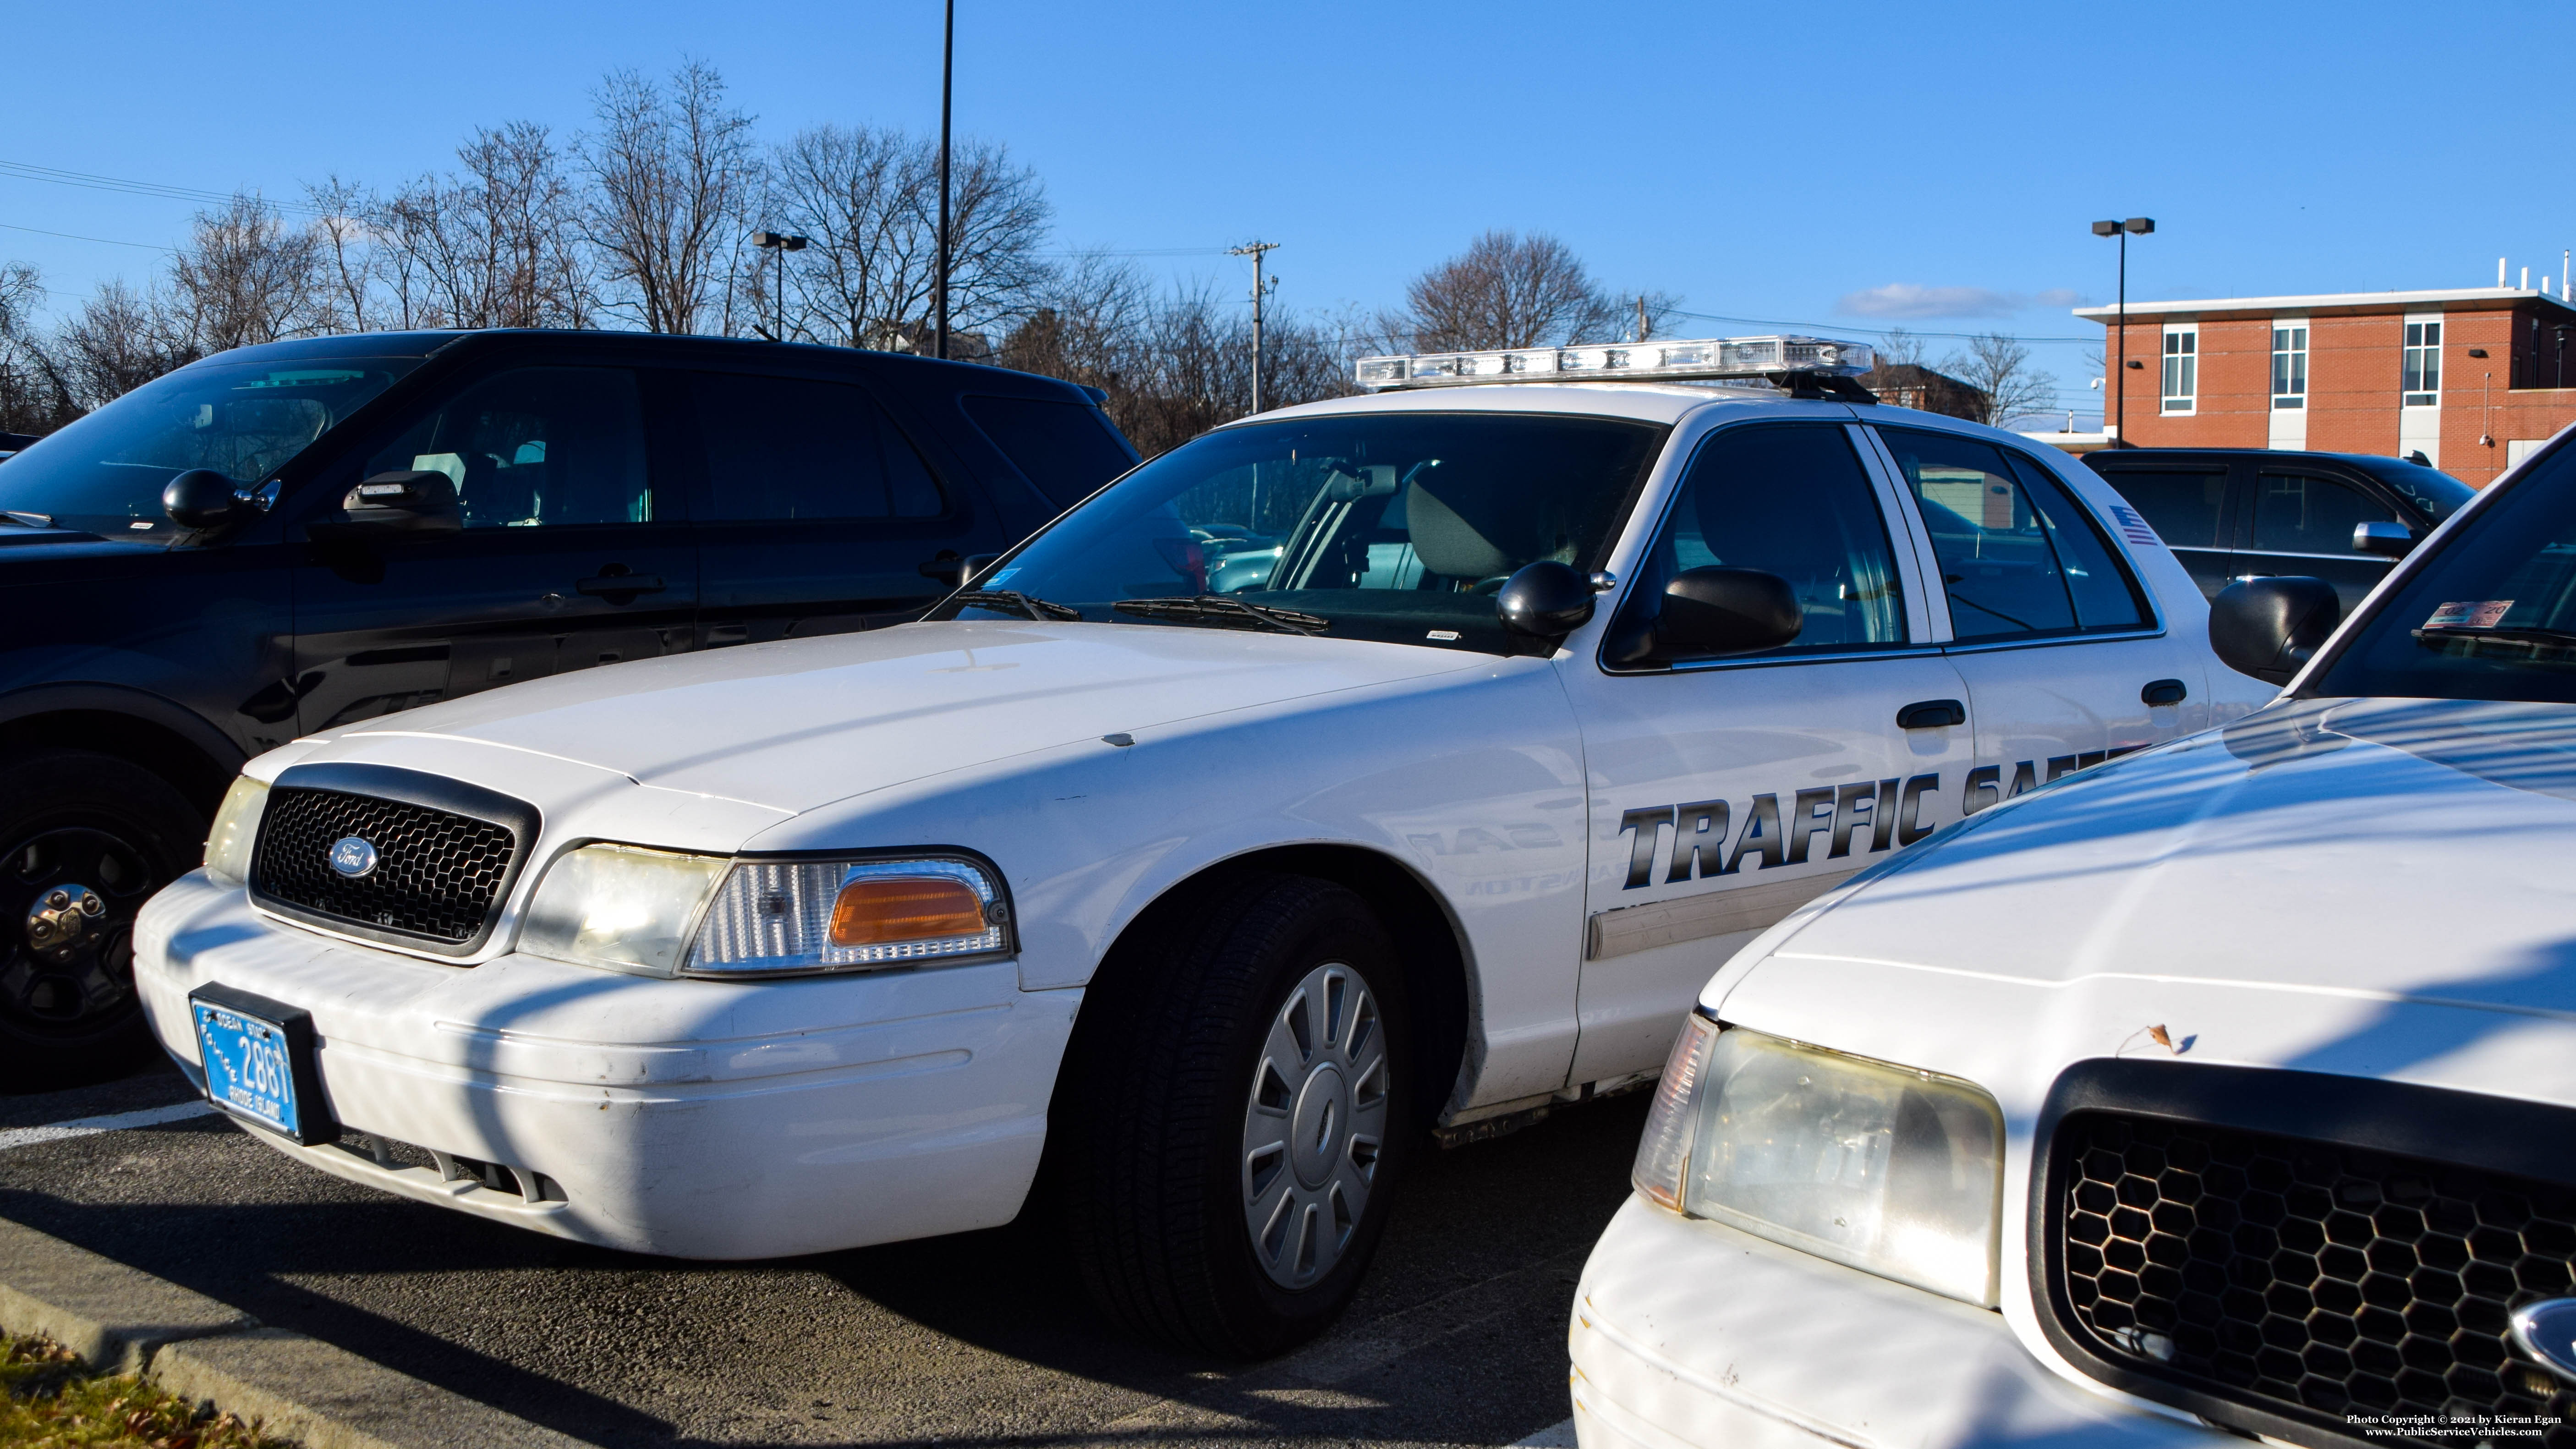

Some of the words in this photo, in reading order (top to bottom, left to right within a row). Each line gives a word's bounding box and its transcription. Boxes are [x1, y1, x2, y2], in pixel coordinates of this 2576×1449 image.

[1618, 773, 1940, 890] TRAFFIC
[338, 843, 364, 867] Ford
[216, 1012, 244, 1032] OCEAN
[200, 1024, 238, 1082] POLICE
[229, 1085, 254, 1109] RHODE
[255, 1095, 280, 1121] ISLAND
